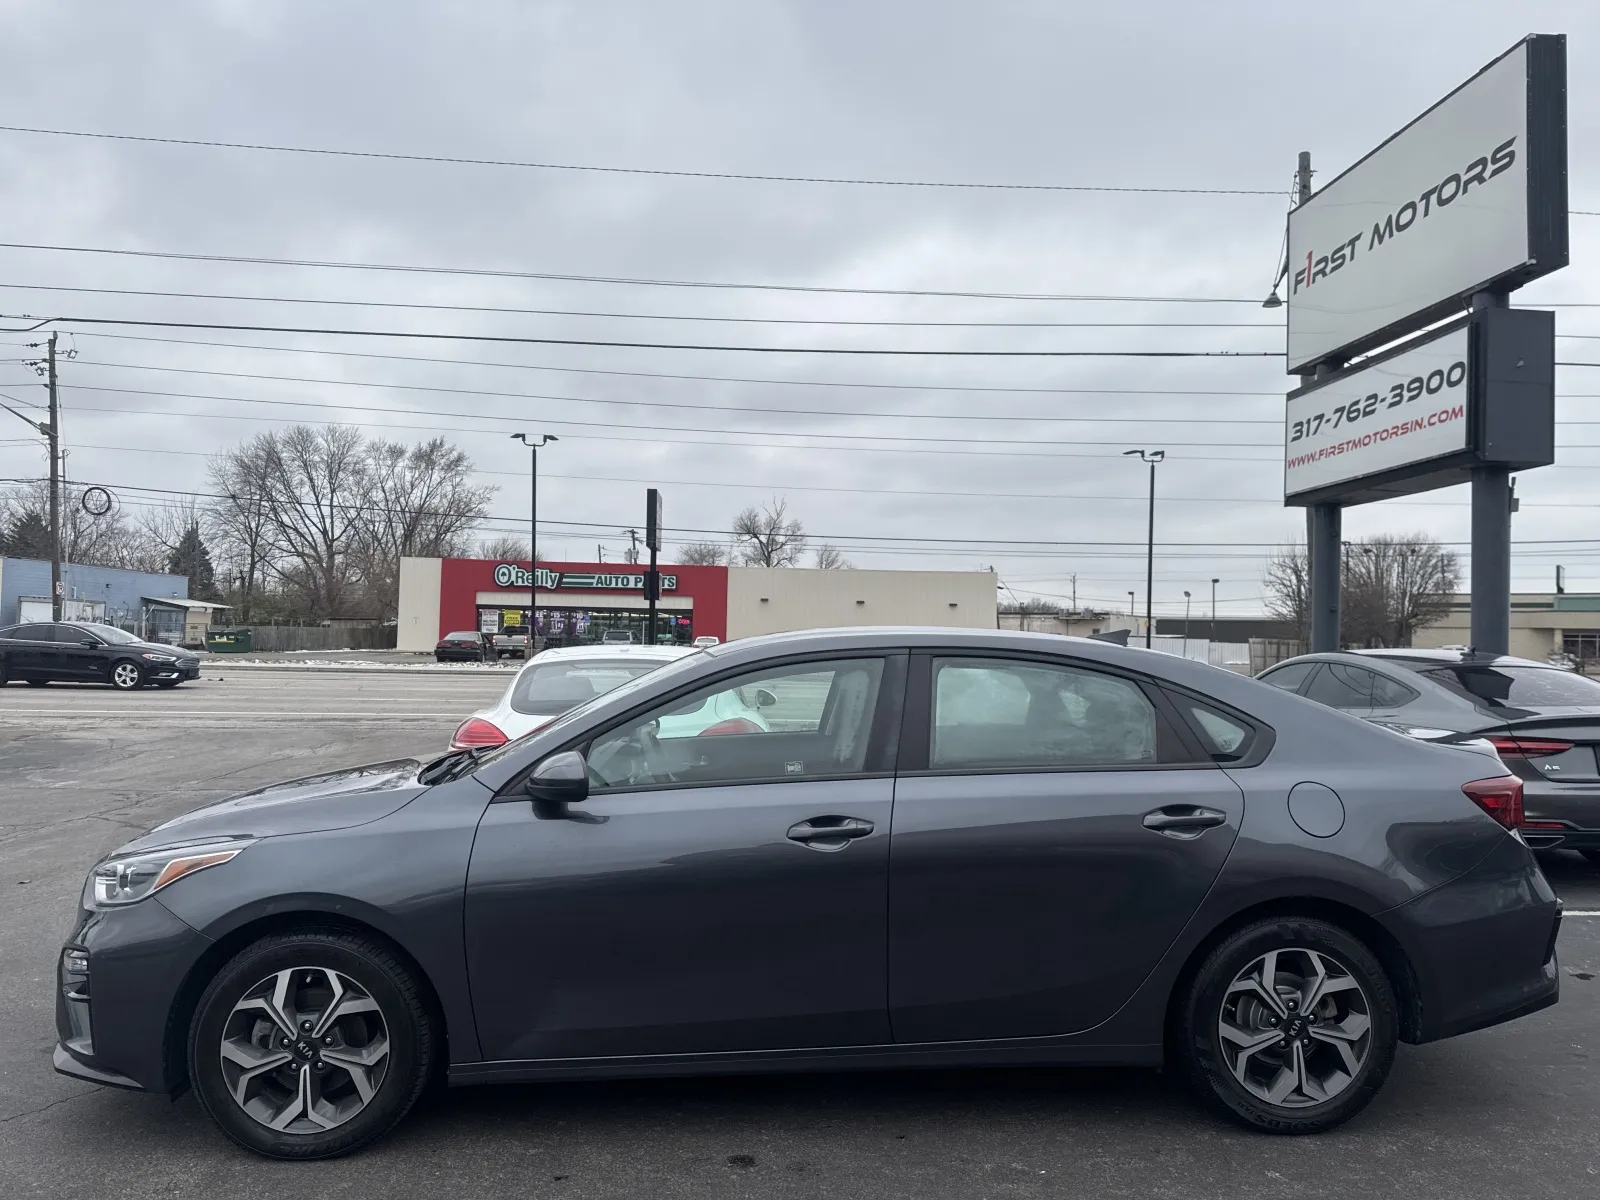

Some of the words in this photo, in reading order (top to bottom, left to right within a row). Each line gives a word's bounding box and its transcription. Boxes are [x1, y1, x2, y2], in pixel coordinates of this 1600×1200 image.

[1368, 135, 1517, 252] MOTORS
[1290, 361, 1466, 443] 317-762-3900
[1287, 404, 1464, 469] WWW.FIRSTMOTORSIN.COM
[496, 564, 558, 588] O'Reilly
[595, 575, 629, 587] AUTO
[634, 576, 675, 588] PTS
[297, 1040, 313, 1059] KIA
[1289, 1020, 1301, 1036] KIA
